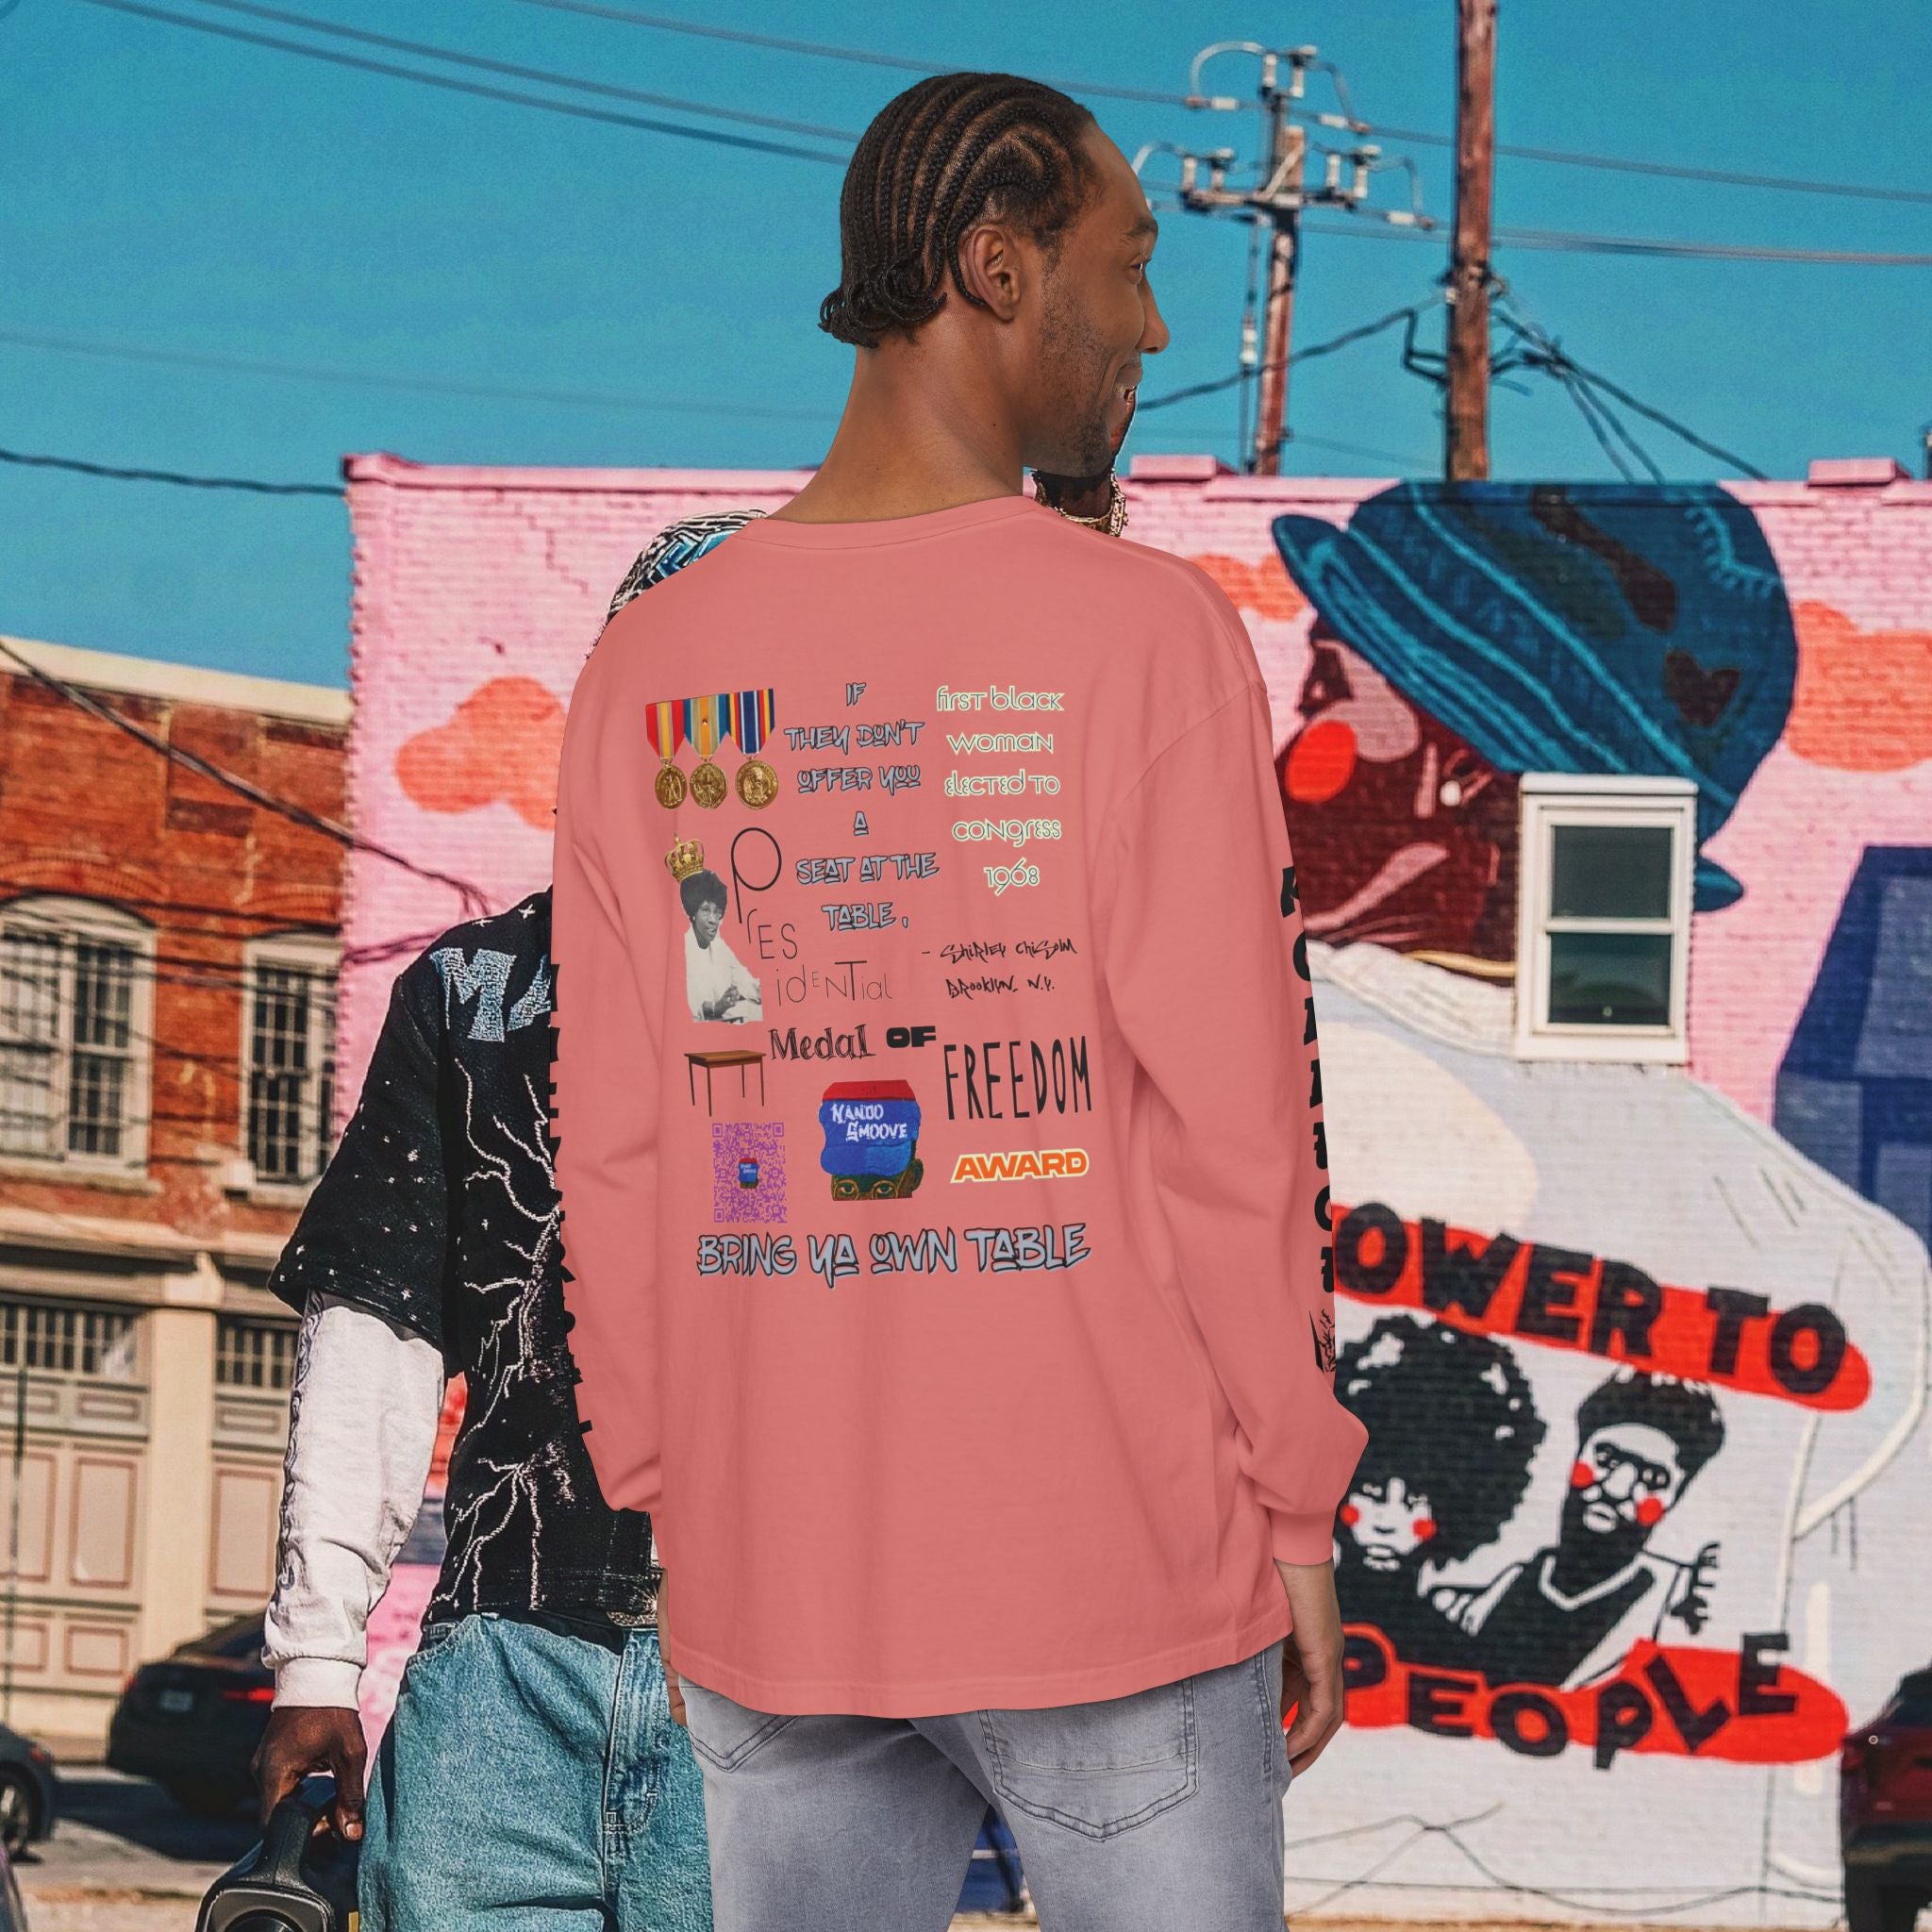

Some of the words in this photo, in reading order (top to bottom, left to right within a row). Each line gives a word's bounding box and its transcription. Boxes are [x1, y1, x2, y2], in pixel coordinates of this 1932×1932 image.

[846, 682, 866, 707] IF
[990, 685, 1065, 711] black
[784, 725, 850, 755] THEY
[857, 719, 924, 748] DON'T
[798, 767, 873, 794] OFFER
[878, 764, 921, 796] YOU
[853, 811, 869, 836] A
[796, 857, 855, 884] SEAT
[859, 856, 888, 882] AT
[890, 852, 940, 879] THE
[984, 857, 1040, 896] 1968
[768, 1024, 876, 1061] Medal
[886, 1025, 937, 1049] OF
[943, 1035, 1092, 1121] FREEDOM
[950, 1147, 1090, 1184] AWARD
[697, 1231, 796, 1276] BRING
[807, 1233, 860, 1291] YA
[870, 1227, 956, 1274] OWN
[964, 1223, 1091, 1274] TABLE
[1707, 1285, 1847, 1396] TO
